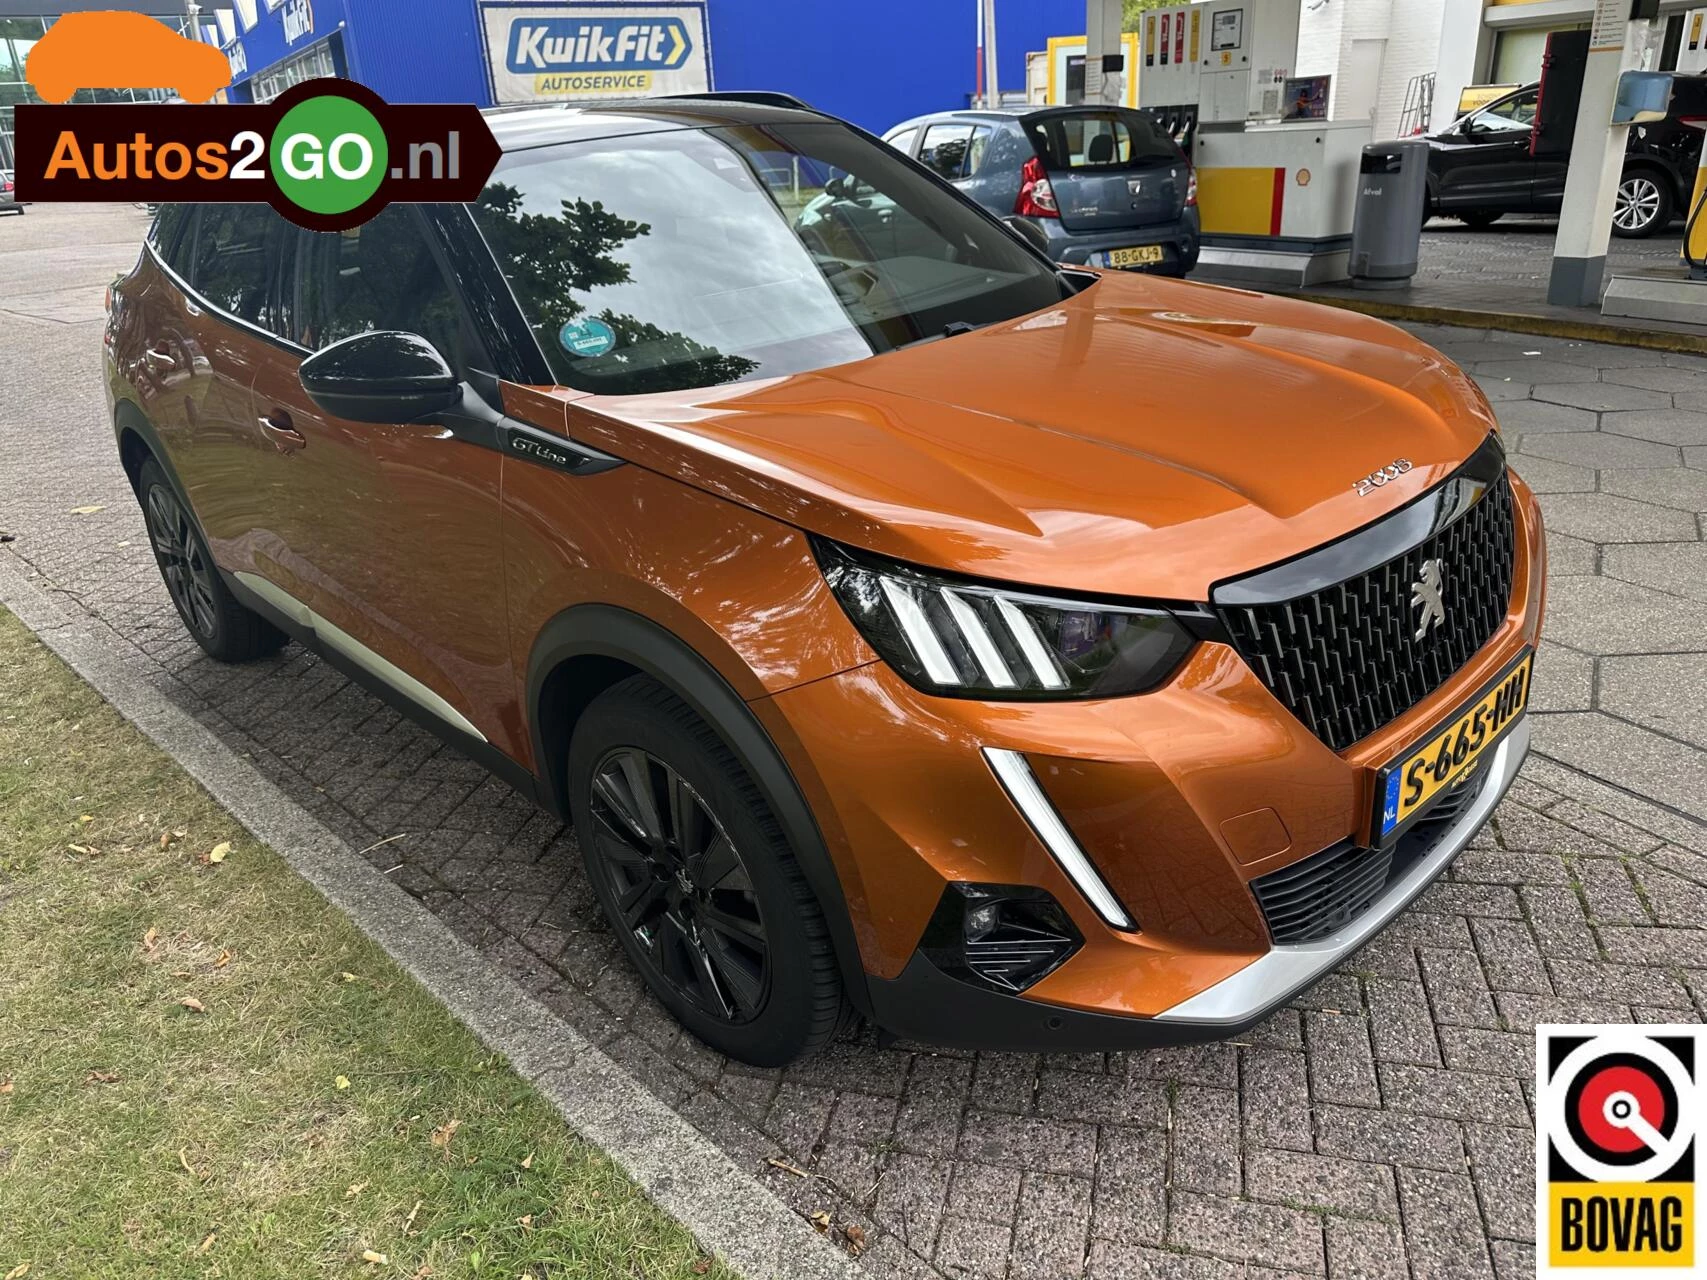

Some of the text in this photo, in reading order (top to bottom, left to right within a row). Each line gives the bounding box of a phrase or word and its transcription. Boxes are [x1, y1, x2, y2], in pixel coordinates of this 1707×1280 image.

[541, 75, 646, 91] AUTOSERVICE
[1114, 247, 1159, 264] 88-GKJ-9
[1352, 458, 1413, 497] 2008
[1404, 666, 1525, 807] S-665-HH
[1383, 809, 1396, 825] NL
